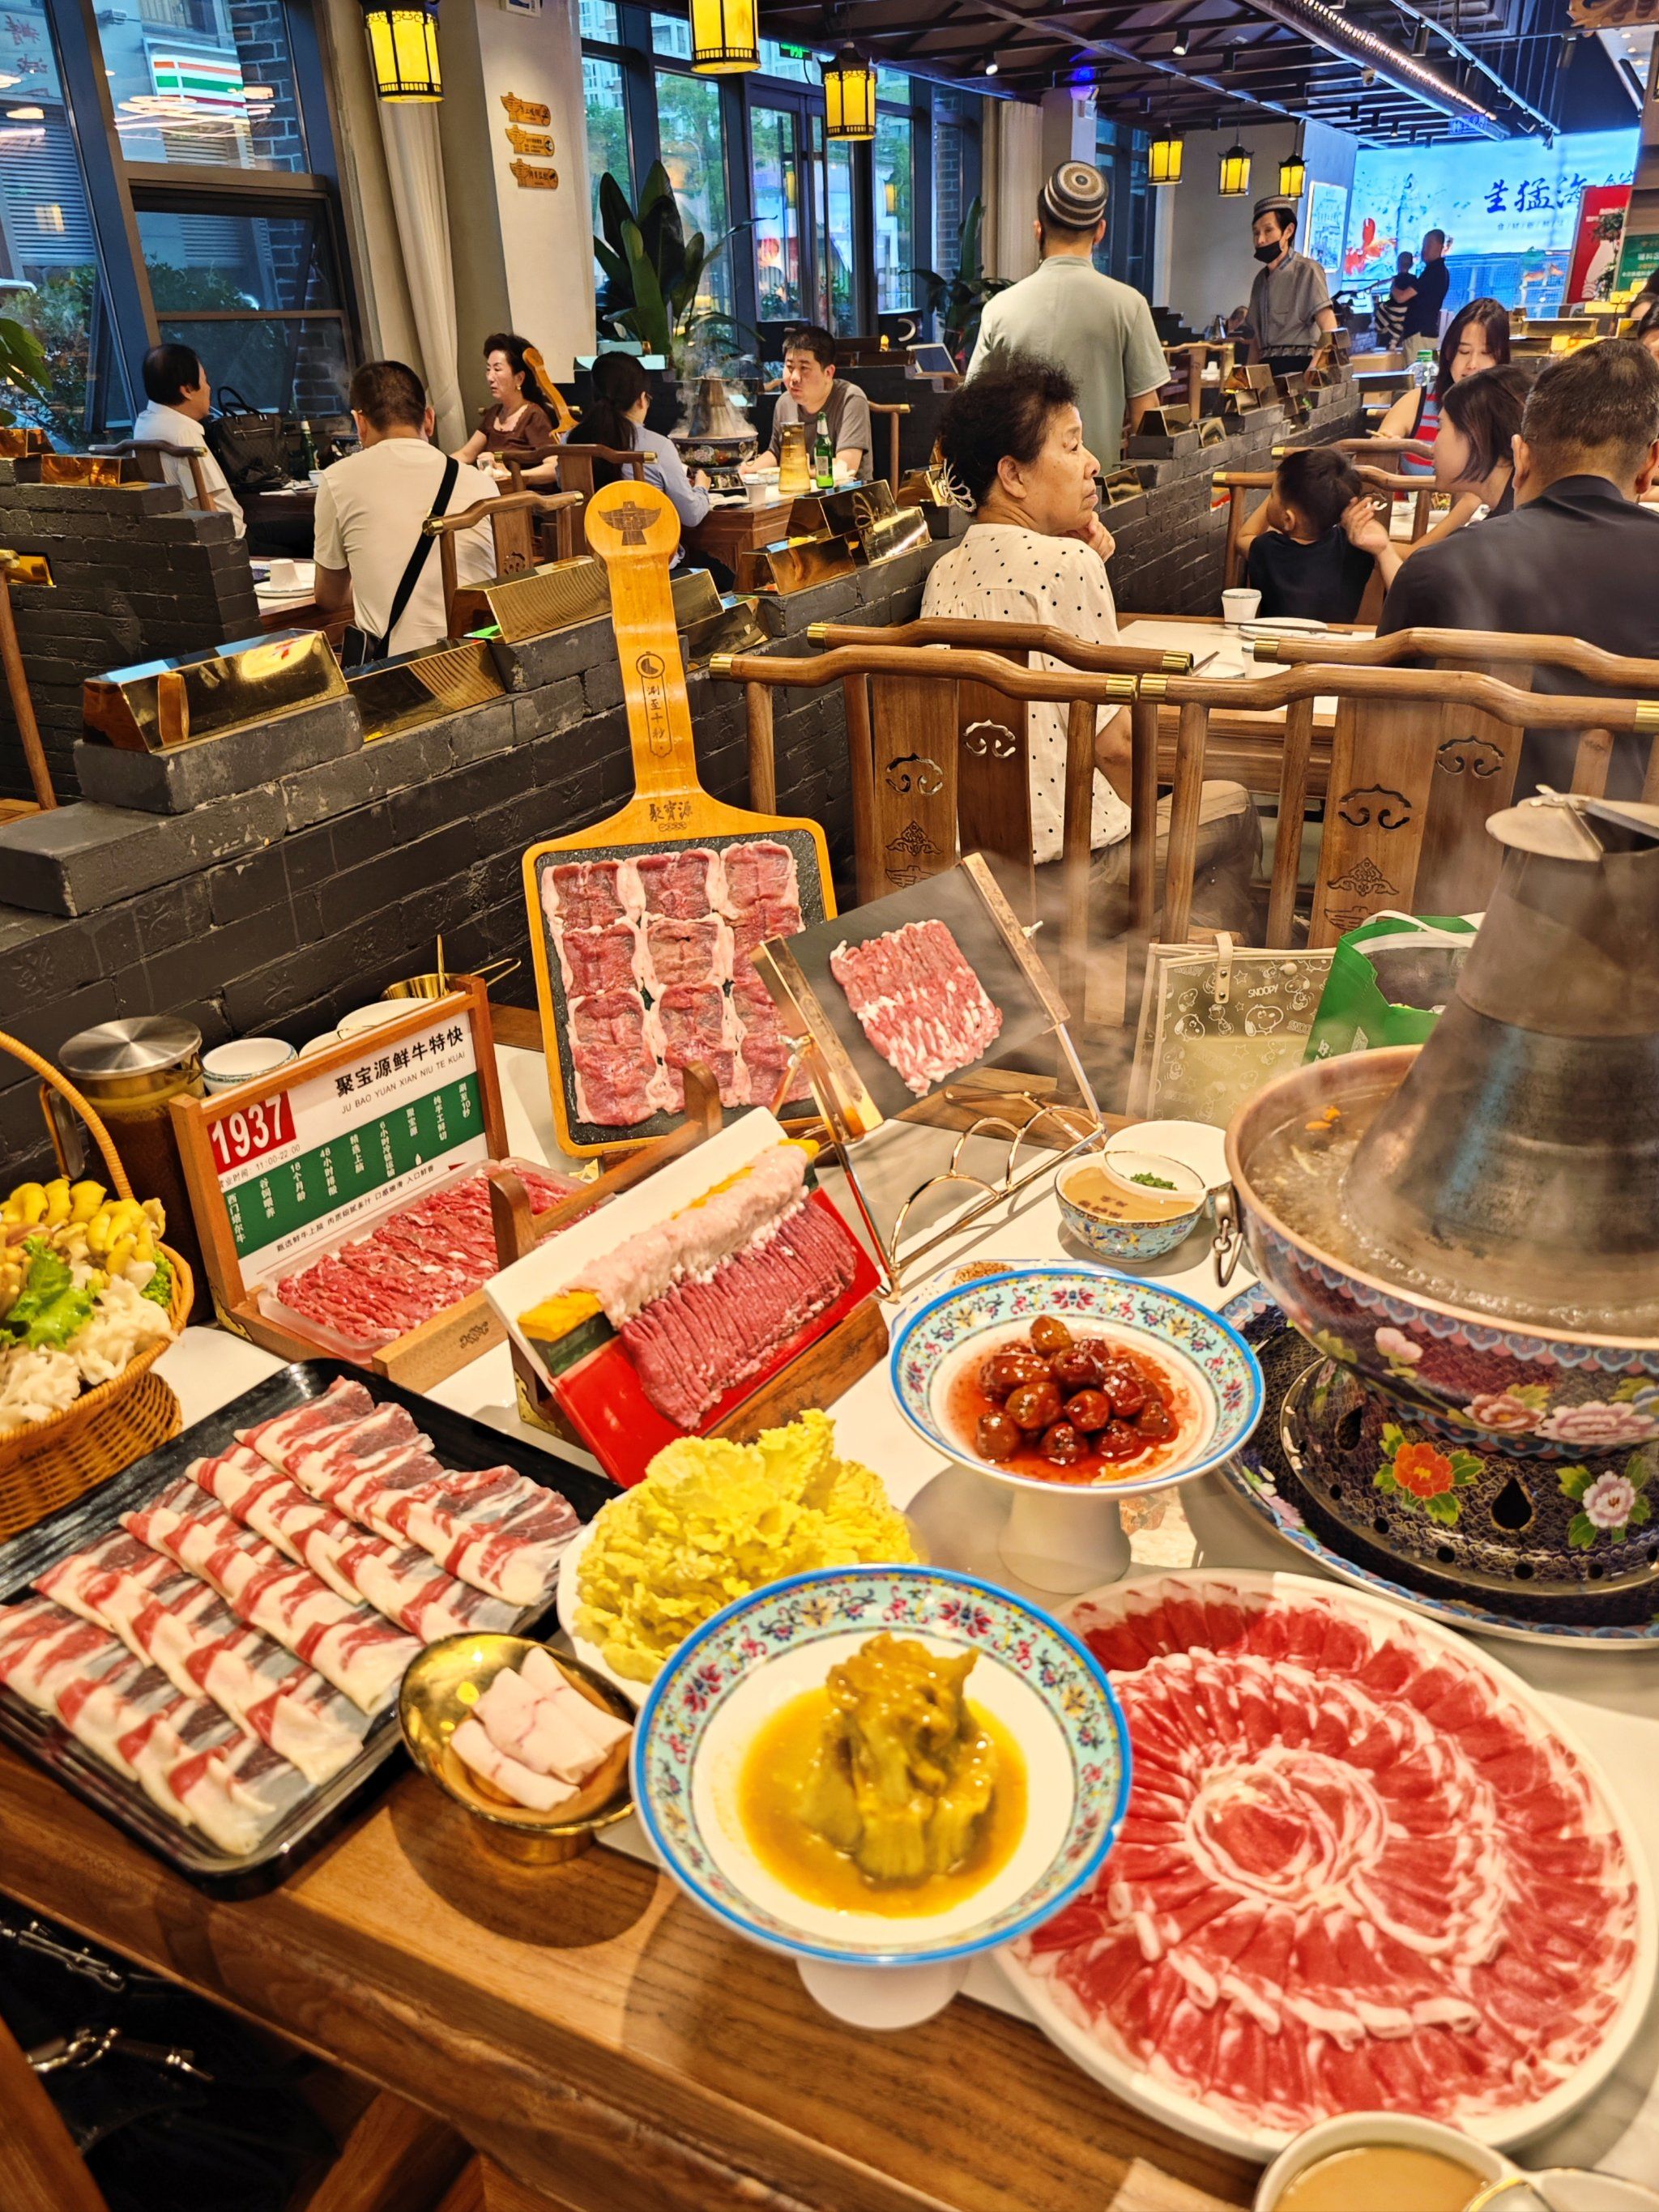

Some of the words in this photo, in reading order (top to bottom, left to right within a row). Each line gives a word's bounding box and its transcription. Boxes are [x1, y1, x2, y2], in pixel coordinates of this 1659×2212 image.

[647, 685, 665, 739] 涮至十秒
[1247, 984, 1279, 998] SNOOPY
[335, 1025, 463, 1097] 聚宝源鲜牛特快
[342, 1104, 352, 1115] JU
[355, 1096, 372, 1108] BAO
[374, 1084, 396, 1098] YUAN
[399, 1073, 418, 1087] XIAN
[420, 1066, 433, 1076] NIU
[436, 1061, 446, 1069] TE
[449, 1052, 465, 1064] KUAI
[211, 1093, 282, 1165] 1937
[433, 1095, 447, 1141] 纯手工鲜切
[290, 1161, 306, 1202] 18个月龄
[227, 1193, 245, 1242] 西门塔尔牛
